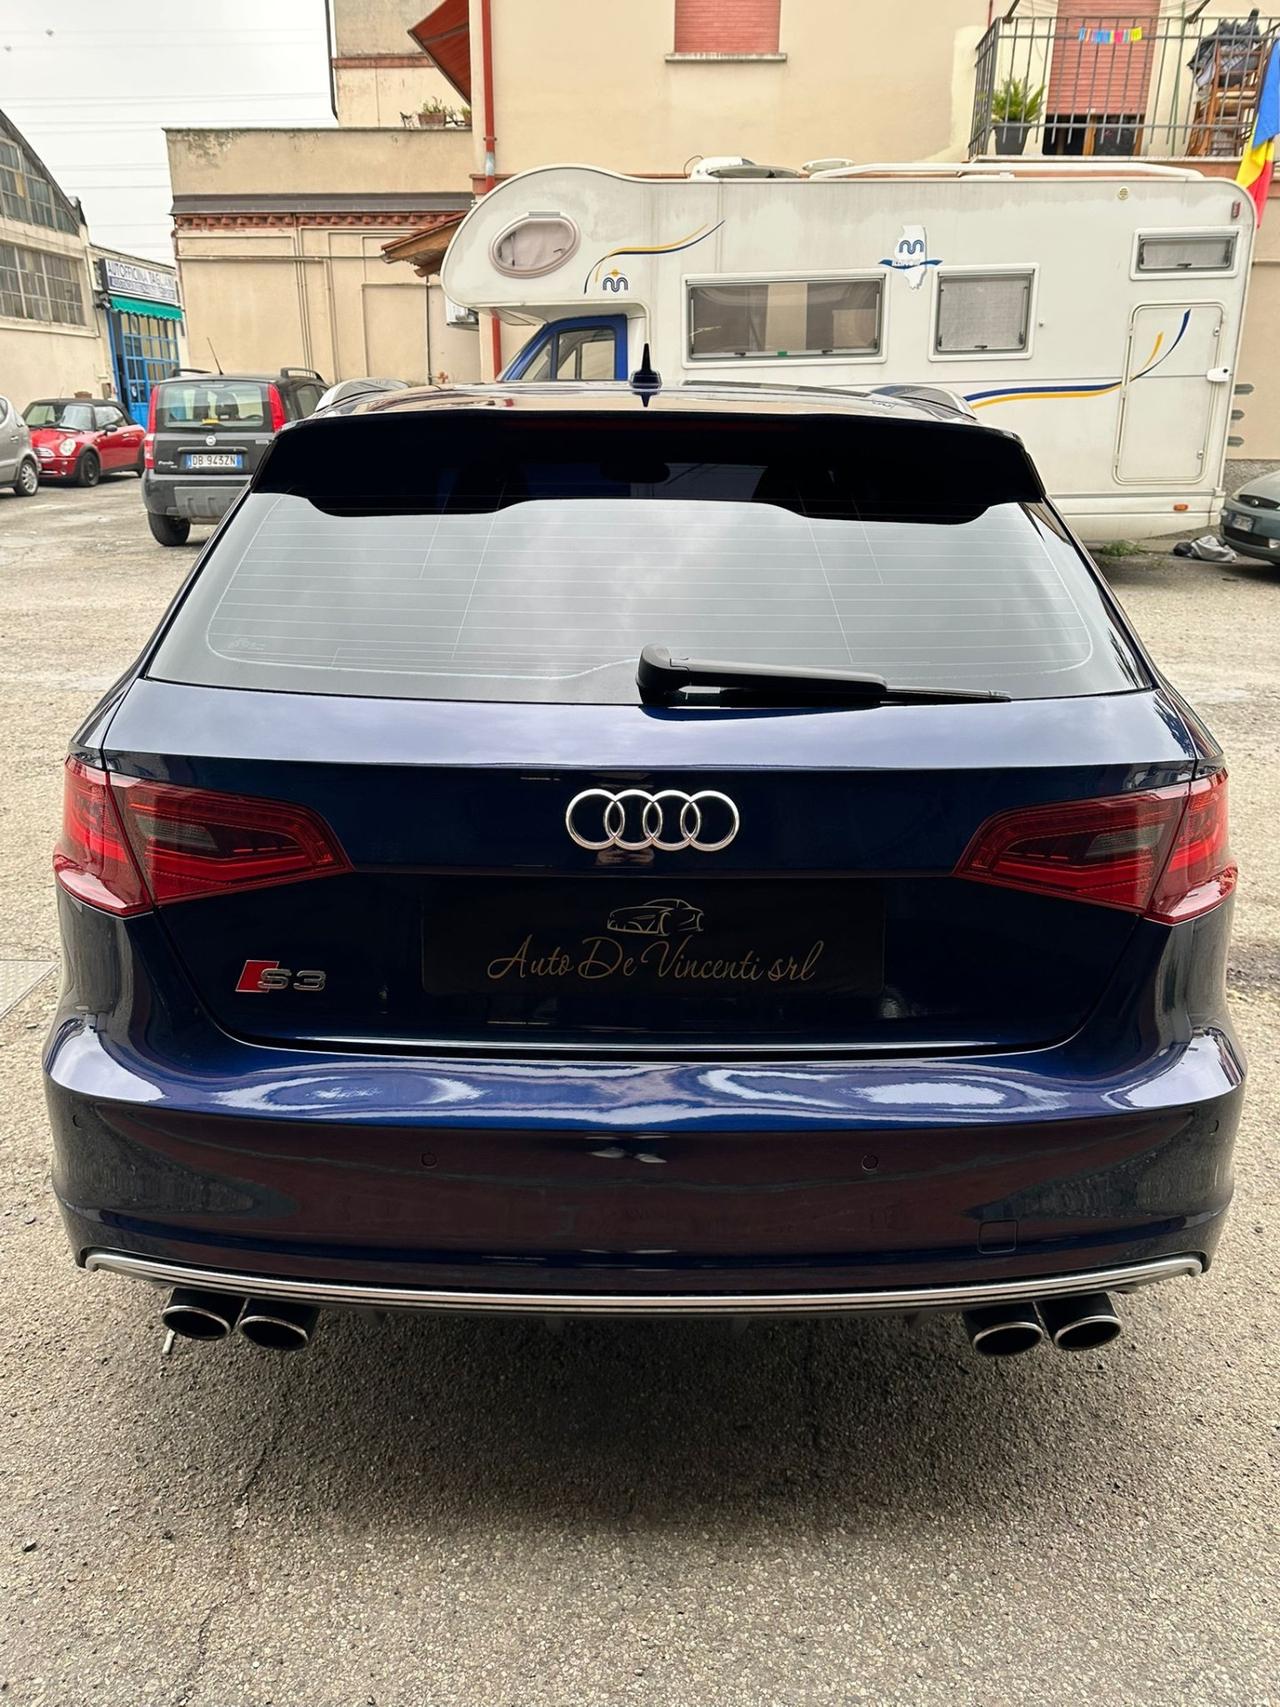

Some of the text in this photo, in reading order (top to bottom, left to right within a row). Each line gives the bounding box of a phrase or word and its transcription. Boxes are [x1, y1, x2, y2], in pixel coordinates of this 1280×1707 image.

[487, 934, 824, 981] Auto De Vincenti srl
[257, 967, 326, 991] S3
